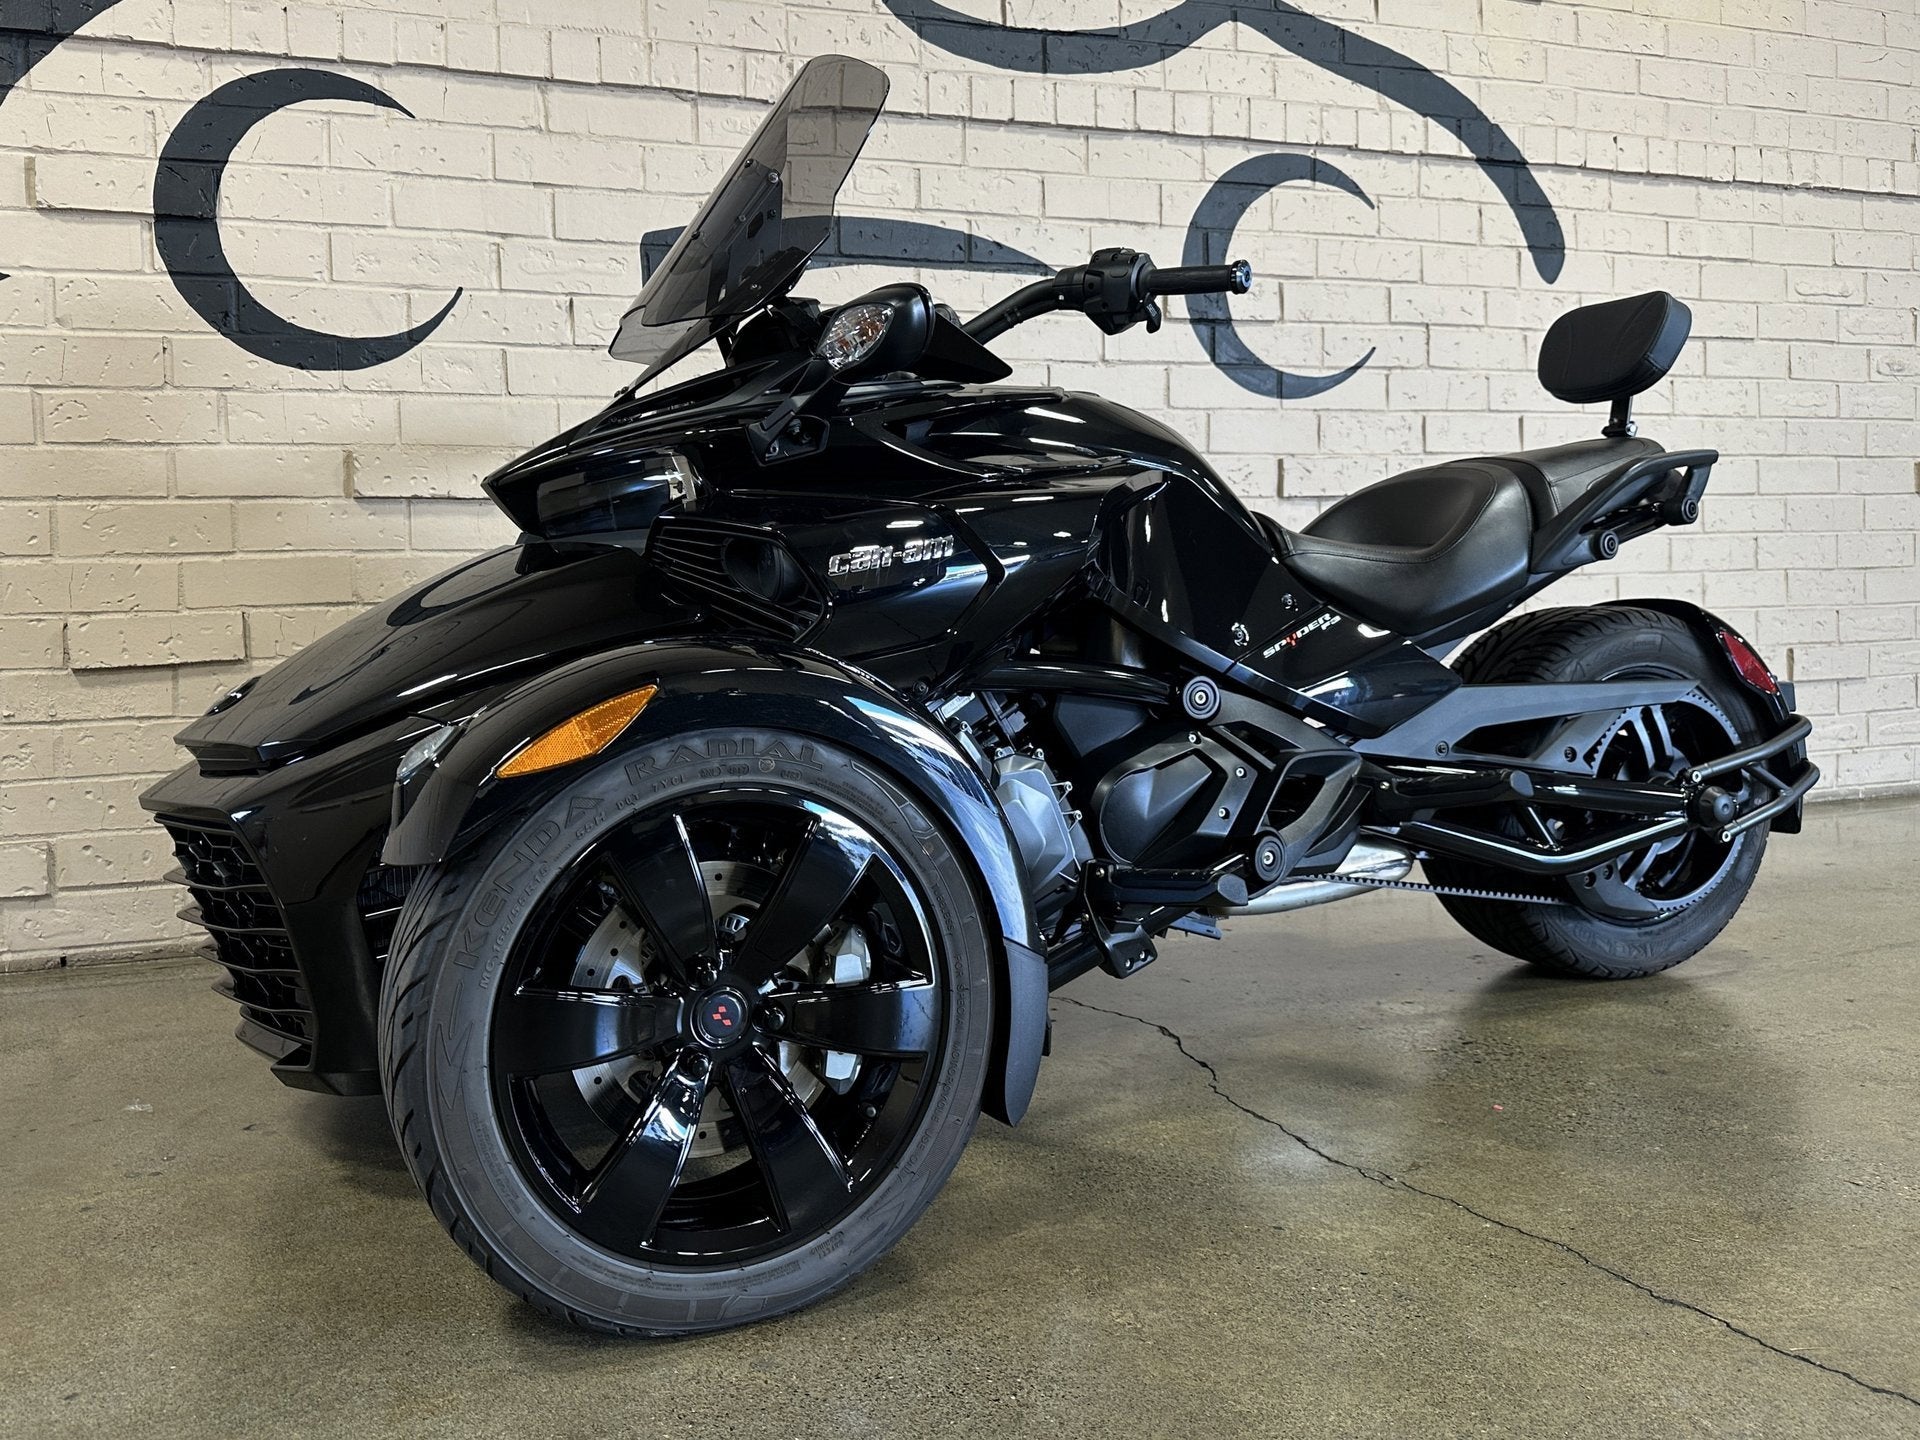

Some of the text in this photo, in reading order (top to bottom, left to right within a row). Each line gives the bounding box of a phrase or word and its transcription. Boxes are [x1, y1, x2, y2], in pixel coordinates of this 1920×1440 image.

[453, 737, 824, 970] KENDA RADIAL
[930, 882, 955, 934] TUBELESS
[953, 955, 965, 978] FOR
